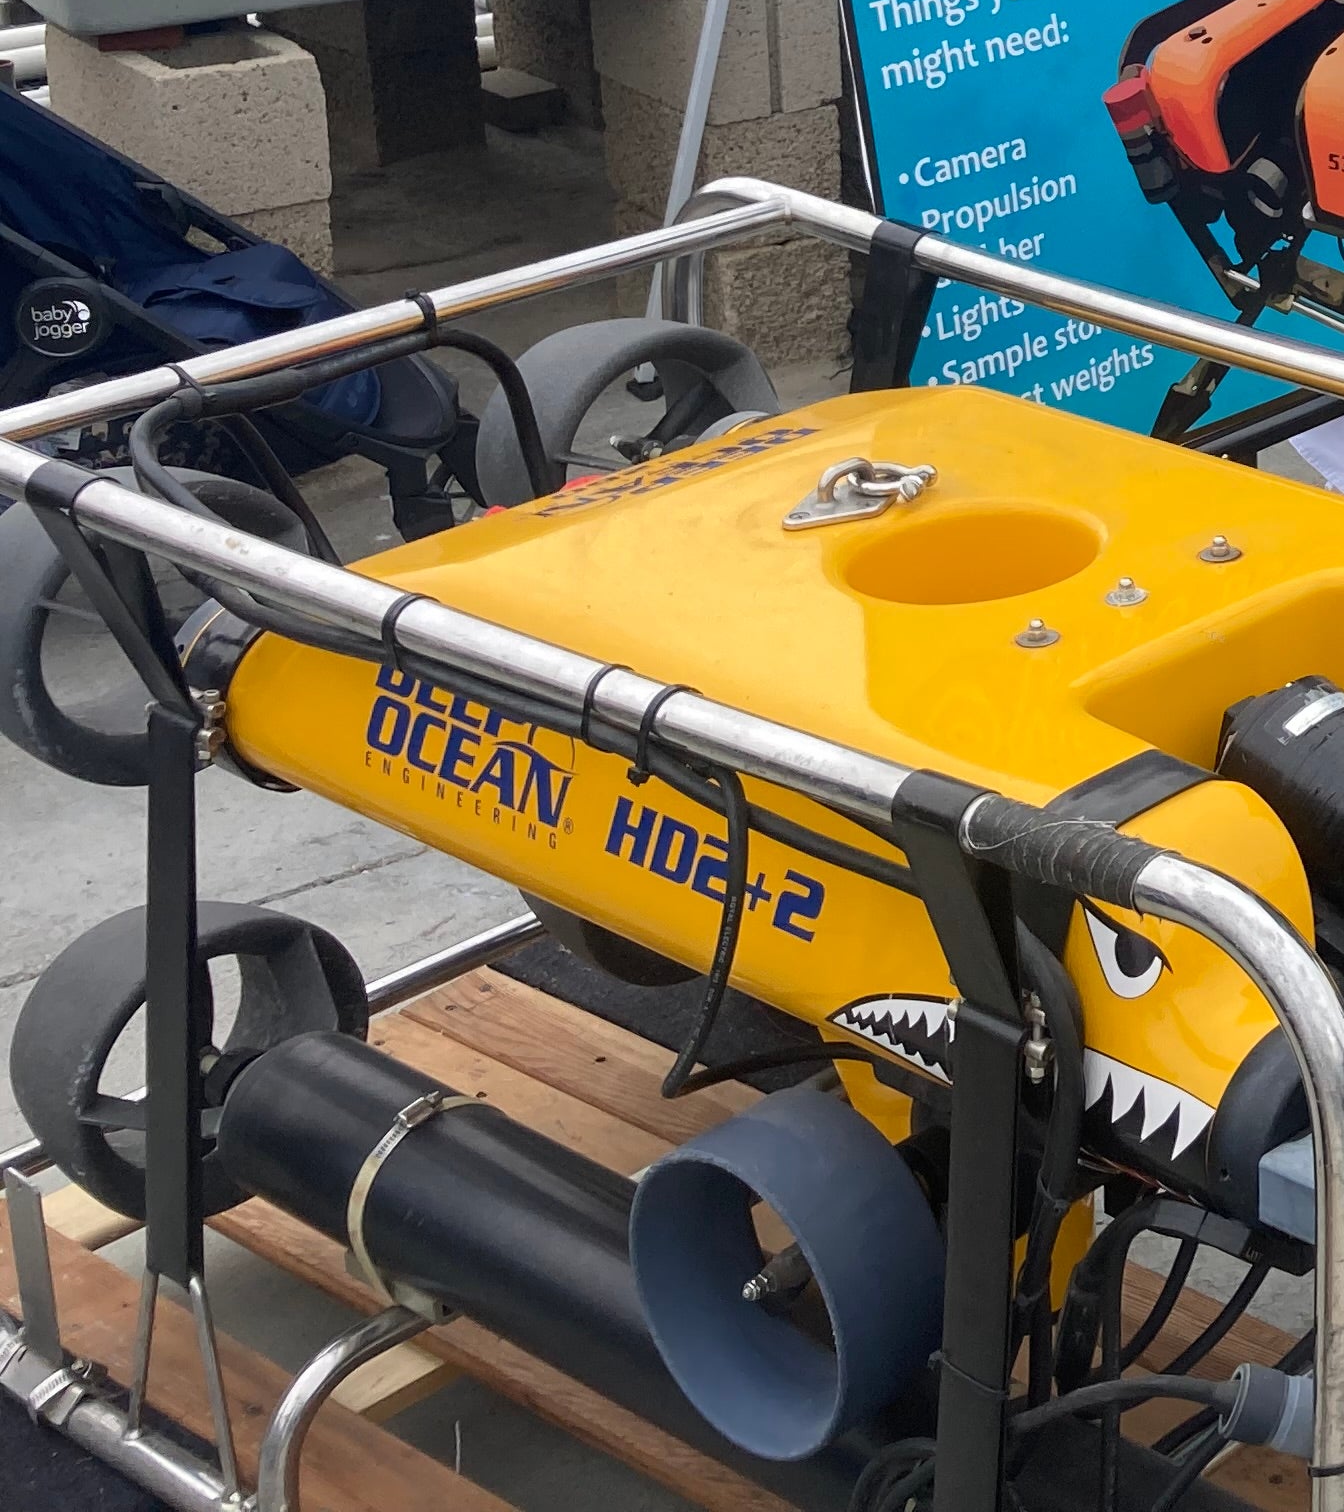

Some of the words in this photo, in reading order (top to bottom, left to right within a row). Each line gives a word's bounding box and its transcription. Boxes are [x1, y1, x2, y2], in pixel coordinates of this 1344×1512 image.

[881, 38, 979, 89] might
[985, 13, 1070, 63] need:
[914, 137, 1027, 187] Camera
[921, 174, 1077, 234] Propulsion
[31, 305, 72, 323] baby
[34, 322, 90, 341] jogger
[935, 295, 1025, 341] Lights
[942, 331, 1048, 386] Sample
[1050, 344, 1154, 400] weights
[366, 695, 574, 828] OCEAN
[365, 751, 557, 849] ENGINEERING
